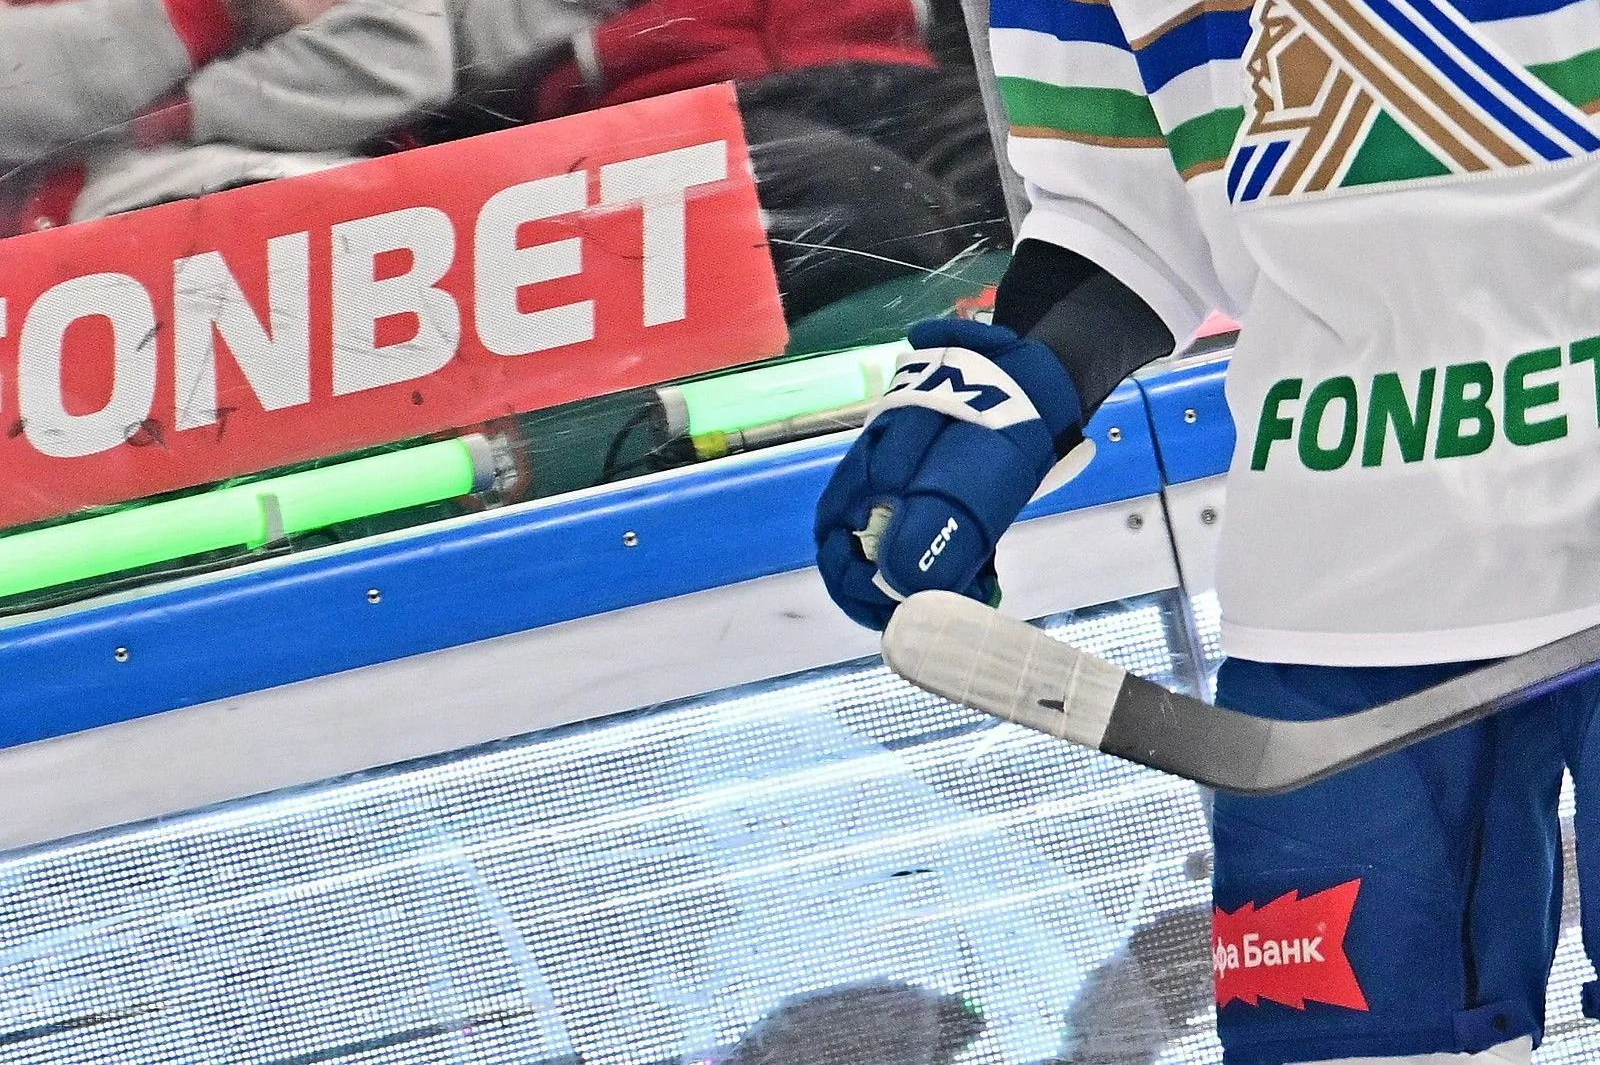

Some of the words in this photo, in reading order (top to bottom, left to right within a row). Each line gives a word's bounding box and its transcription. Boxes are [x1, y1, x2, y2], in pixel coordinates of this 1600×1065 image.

[0, 140, 728, 459] ONBET
[918, 517, 959, 572] CCM
[1243, 933, 1326, 968] Банк
